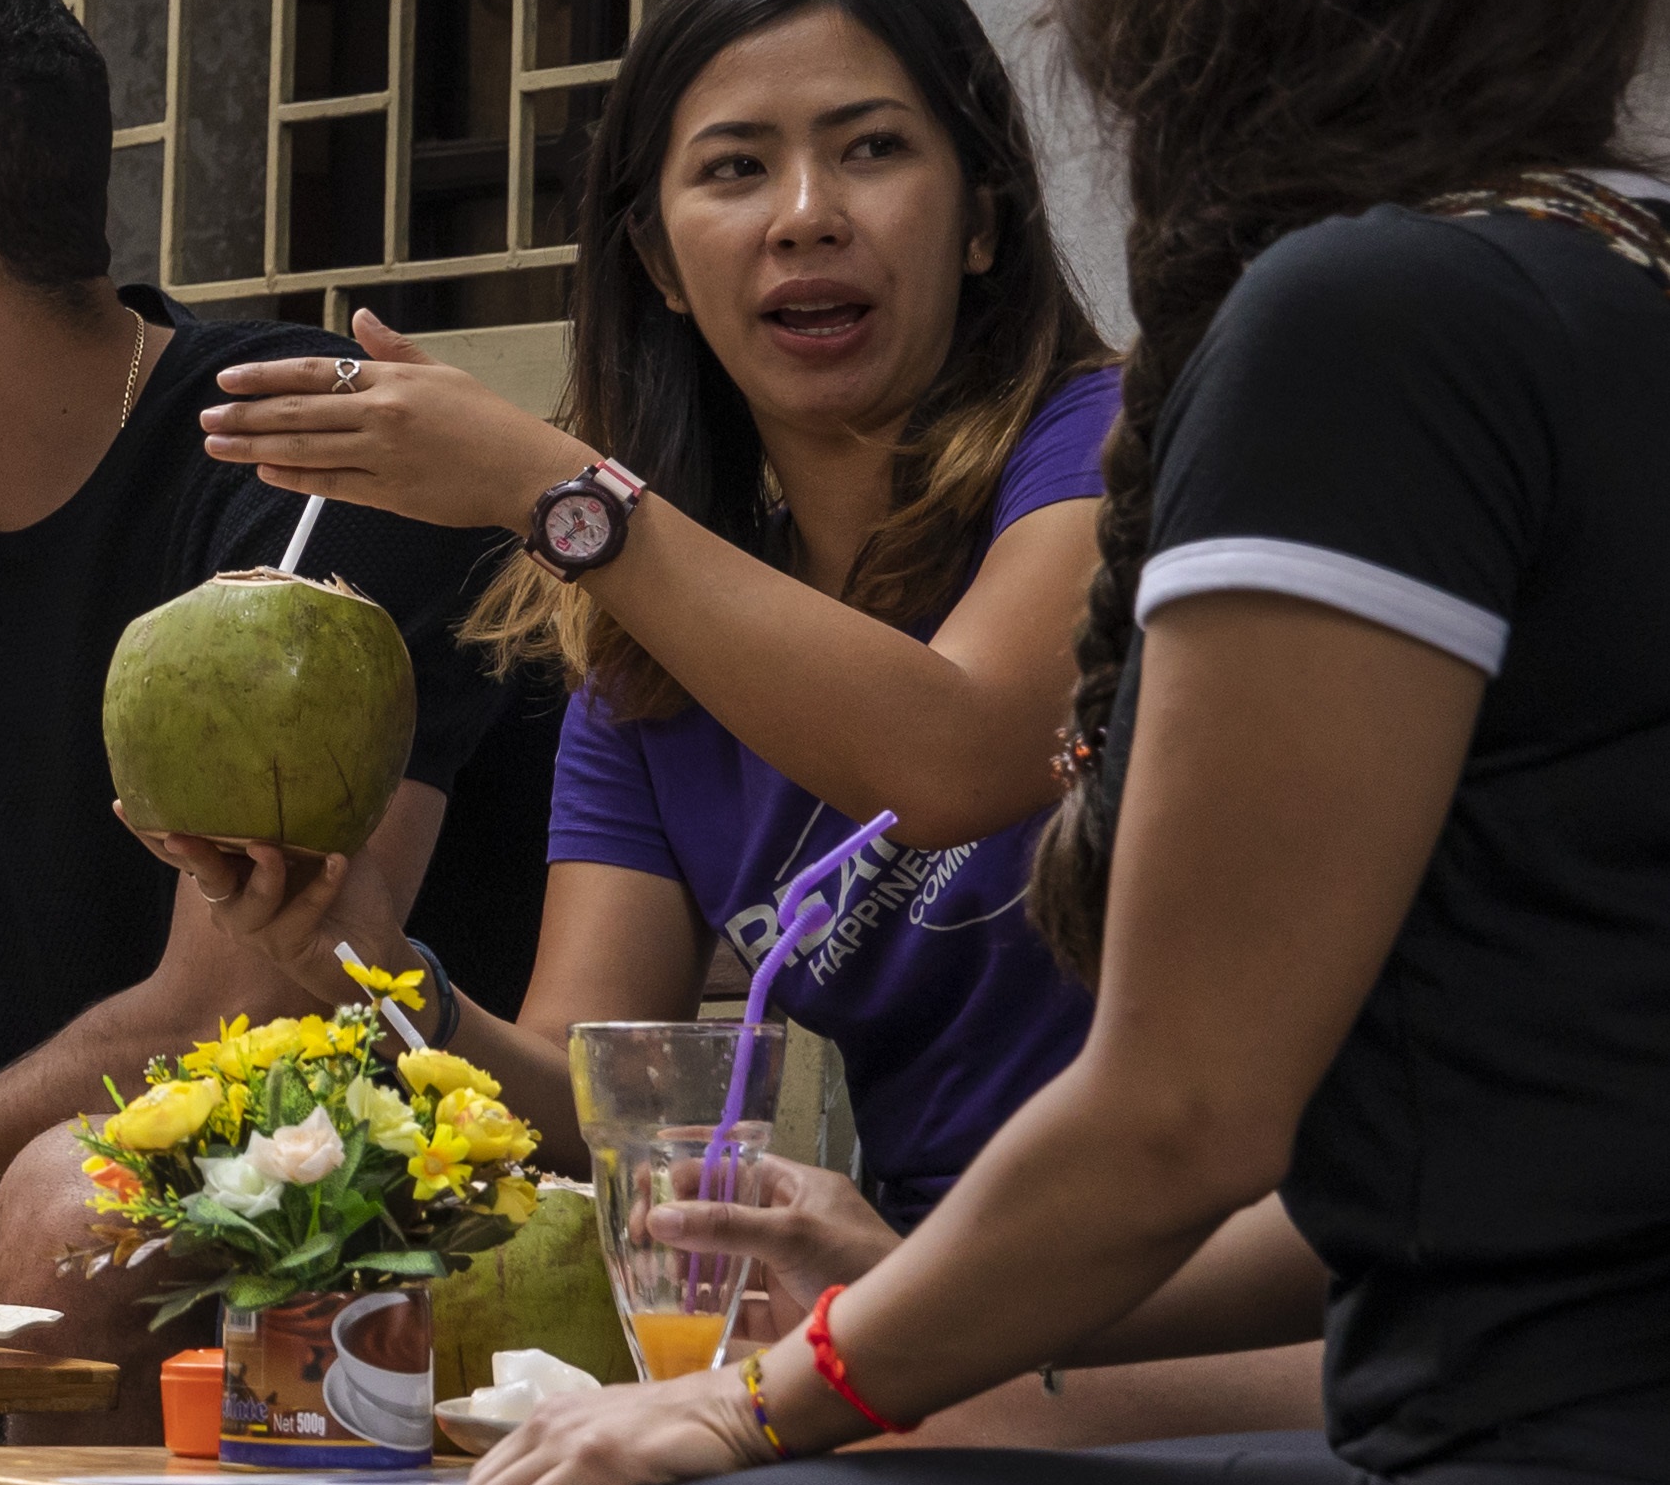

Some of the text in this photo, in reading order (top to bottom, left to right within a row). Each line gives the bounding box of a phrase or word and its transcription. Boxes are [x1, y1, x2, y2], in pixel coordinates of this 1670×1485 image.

[909, 838, 978, 925] COMM
[273, 1411, 326, 1437] Net 500g
